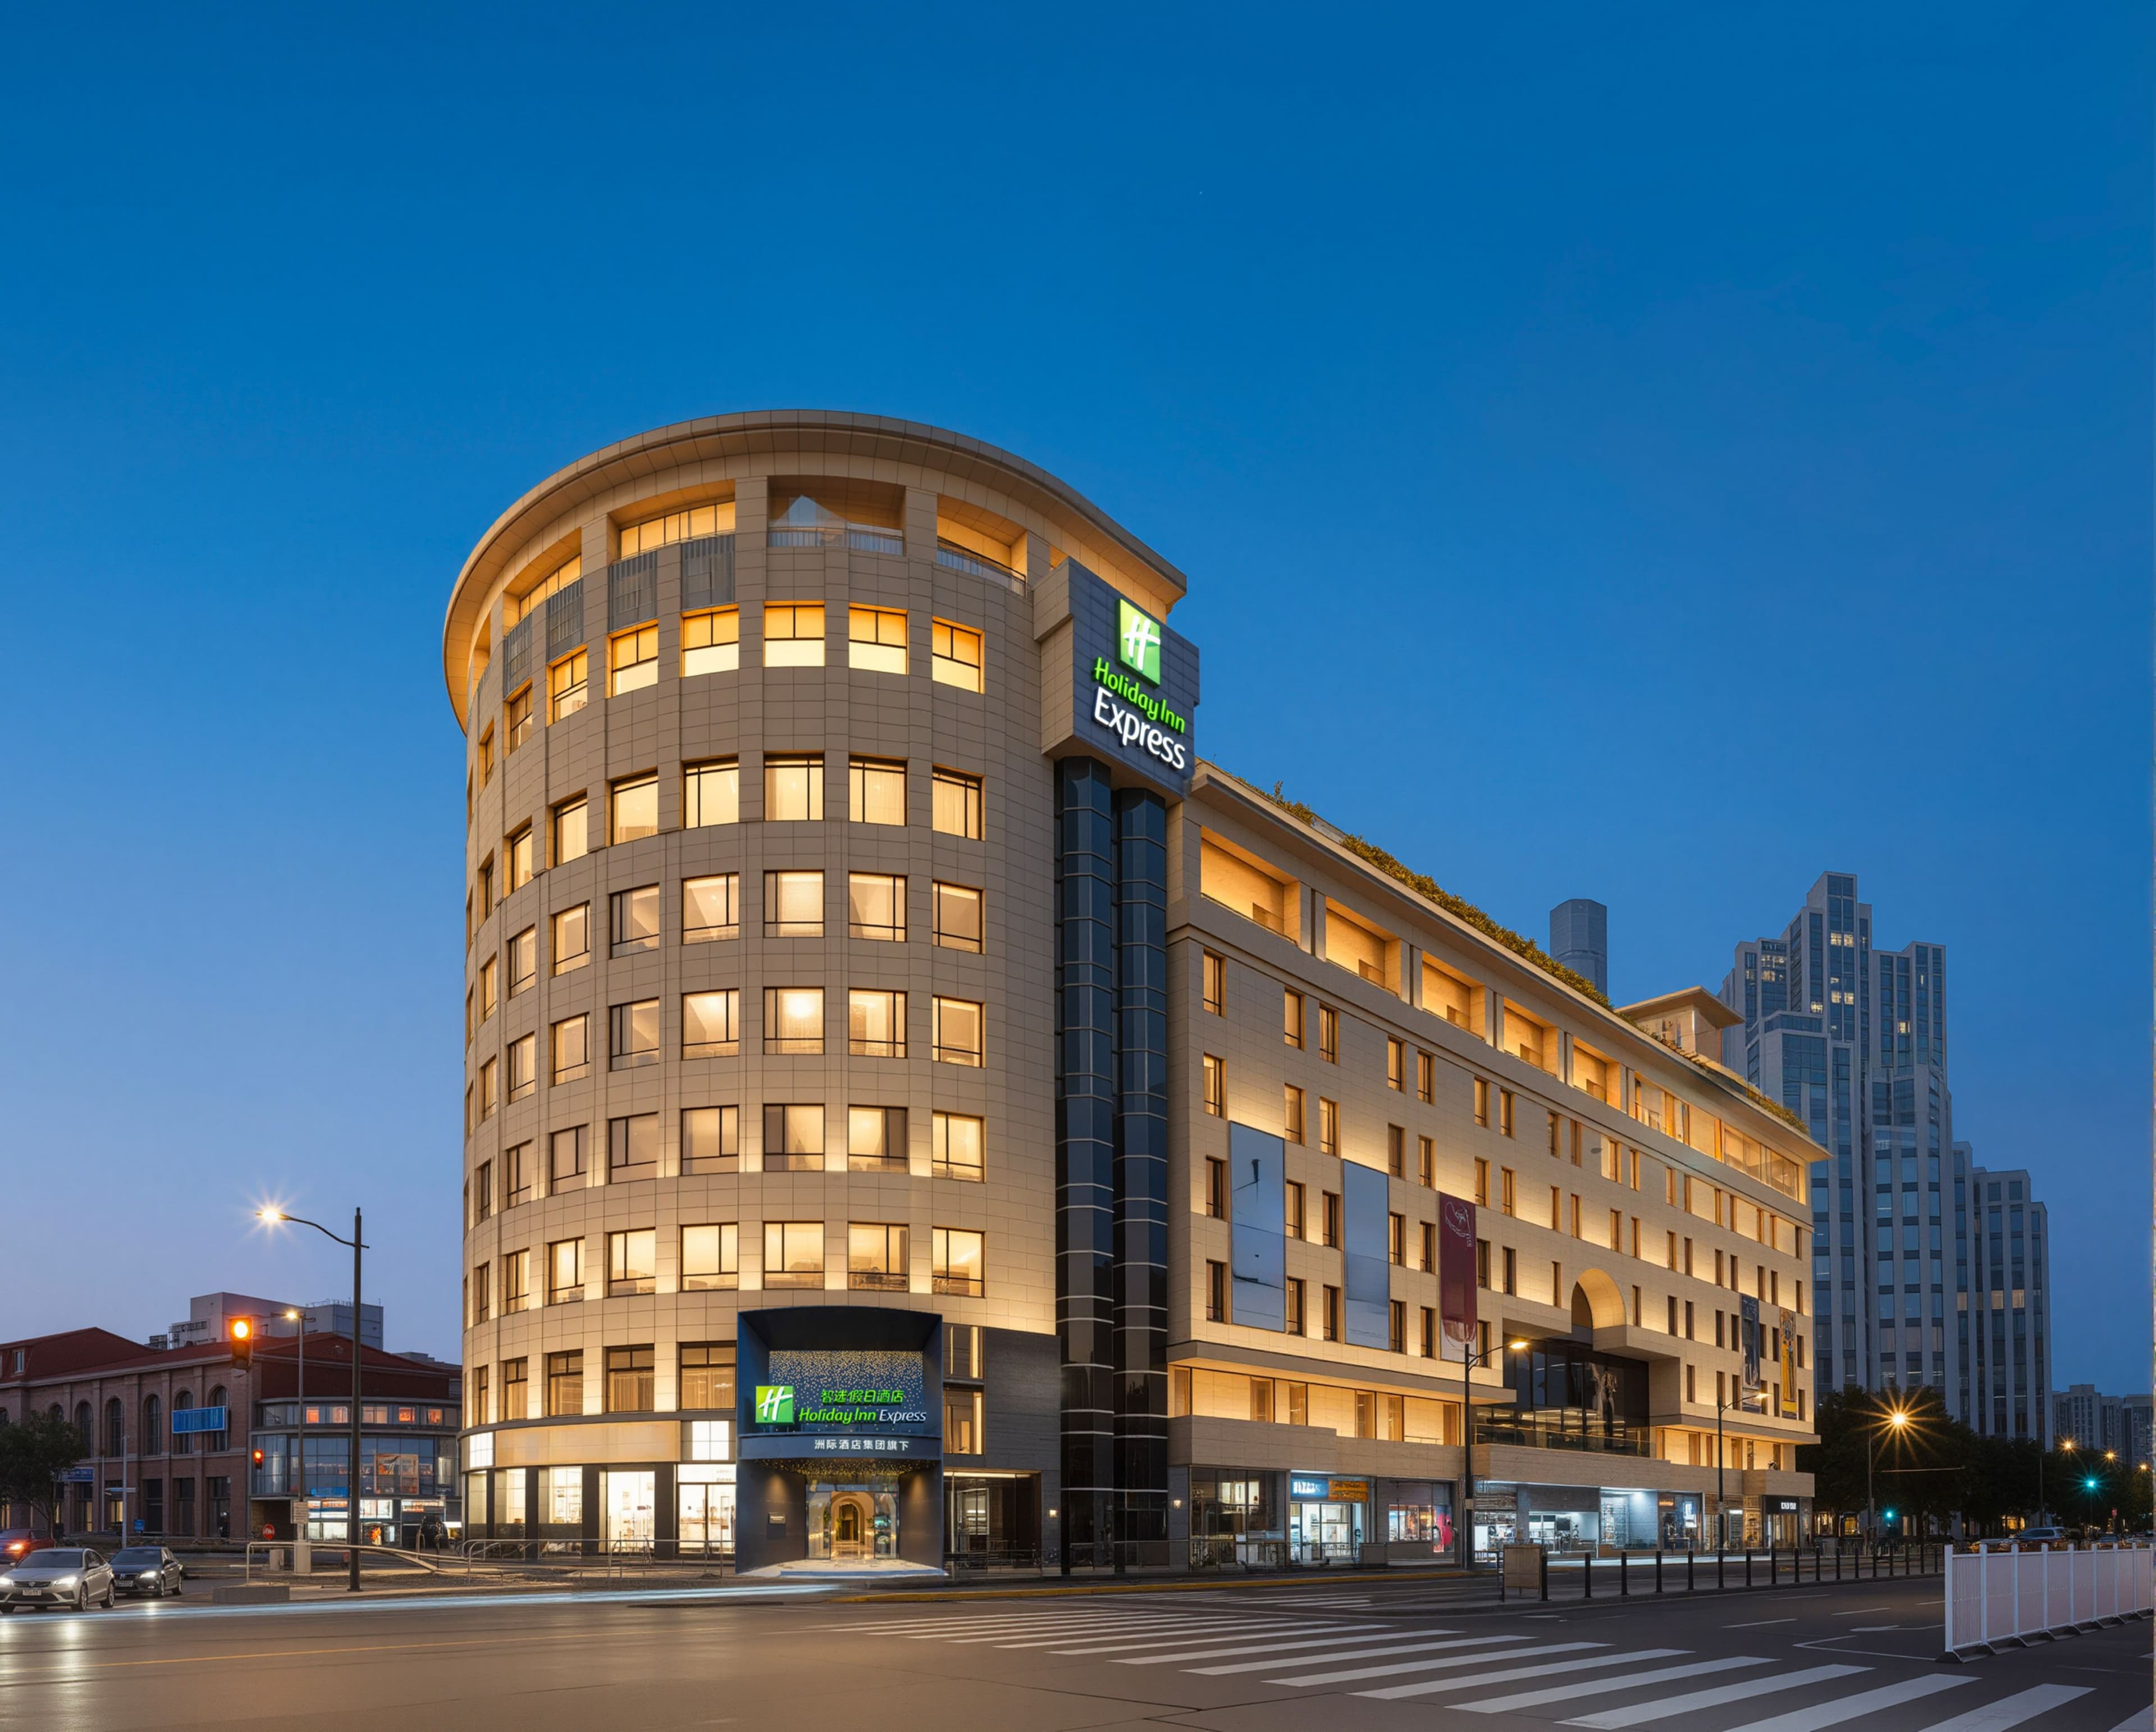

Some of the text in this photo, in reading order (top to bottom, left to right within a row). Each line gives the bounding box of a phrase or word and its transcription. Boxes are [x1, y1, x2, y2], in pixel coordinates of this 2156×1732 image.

[1094, 657, 1186, 734] Holiday Inn
[1095, 686, 1186, 769] Express
[821, 1389, 904, 1403] 智选假日酒店
[798, 1407, 926, 1425] Holiday Inn Express
[815, 1439, 909, 1451] 洲际酒店集团旗下
